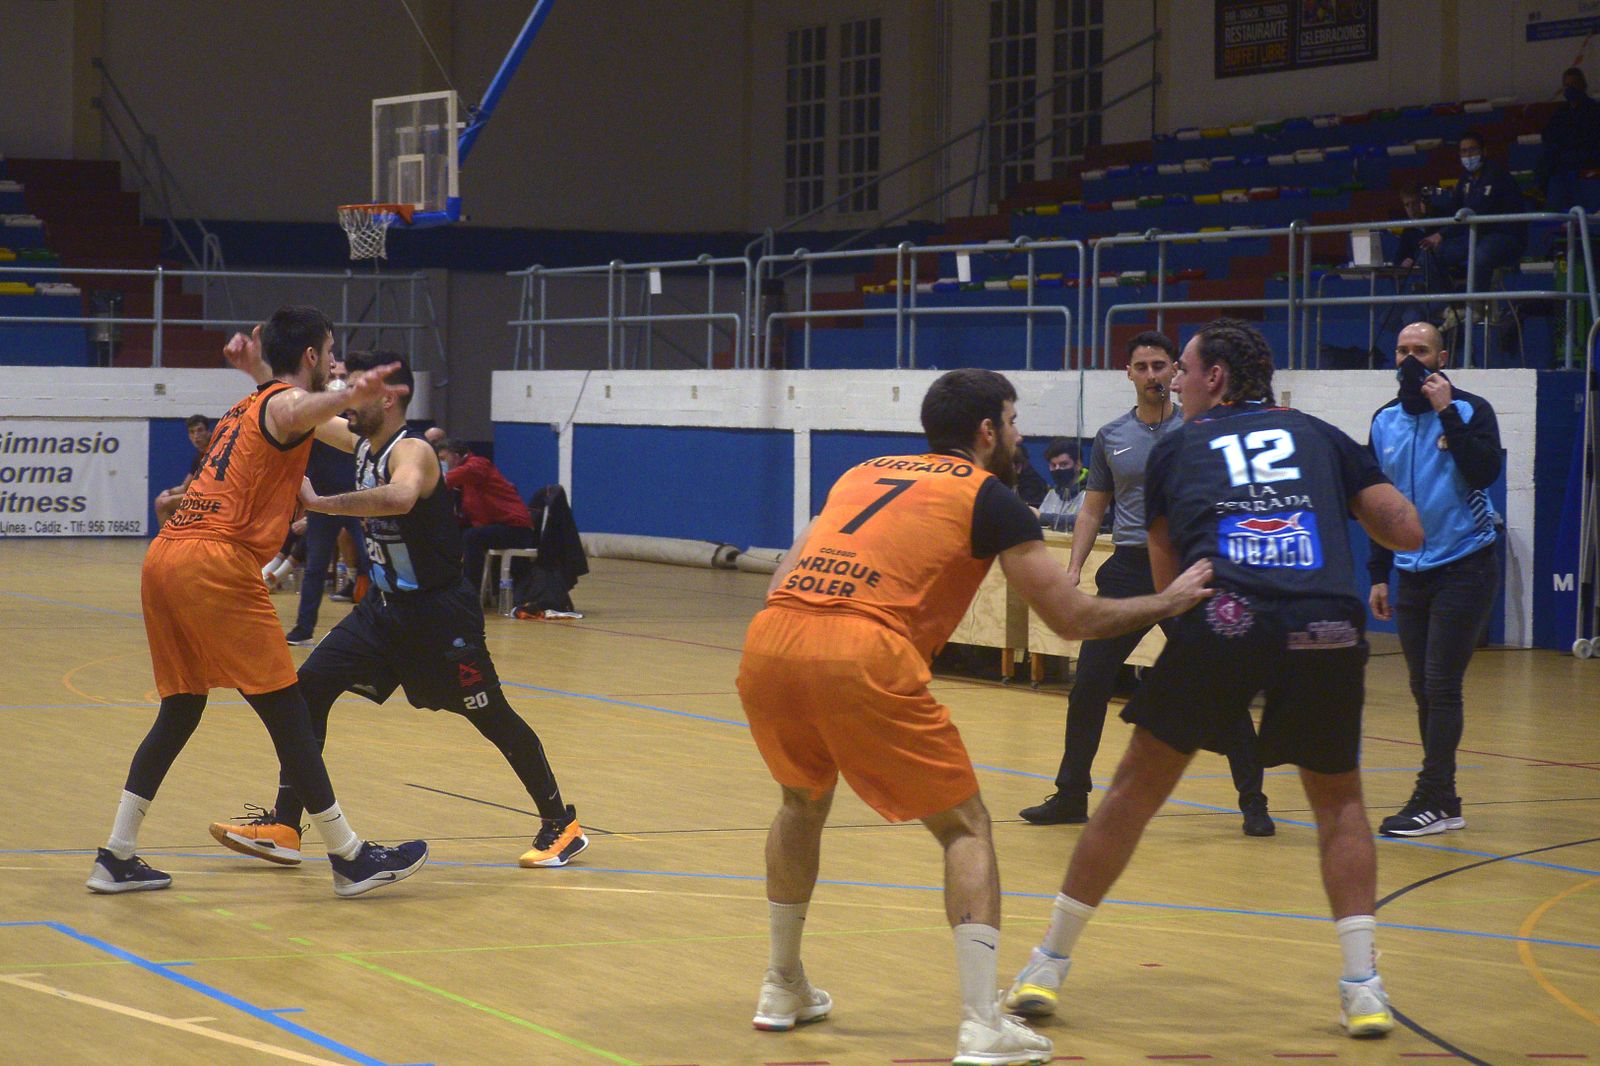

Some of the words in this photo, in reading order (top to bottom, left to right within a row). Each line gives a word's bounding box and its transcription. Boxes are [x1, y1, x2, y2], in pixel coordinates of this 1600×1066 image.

[1224, 19, 1288, 43] RESTAURANTE
[1300, 23, 1367, 46] CELEBRACIONES
[1224, 46, 1258, 66] BUFFET
[0, 432, 119, 454] imnasio
[1208, 428, 1302, 487] 12
[0, 466, 73, 483] orma
[0, 491, 87, 512] itness
[1248, 484, 1278, 498] LA
[838, 477, 918, 535] 7
[88, 521, 105, 533] 956
[108, 521, 140, 533] 766452
[820, 547, 857, 558] COLEGIO
[1227, 535, 1315, 567] UBAGO
[799, 556, 882, 588] NRIQUE
[1552, 573, 1574, 592] M
[785, 574, 857, 598] SOLER
[463, 691, 489, 710] 20
